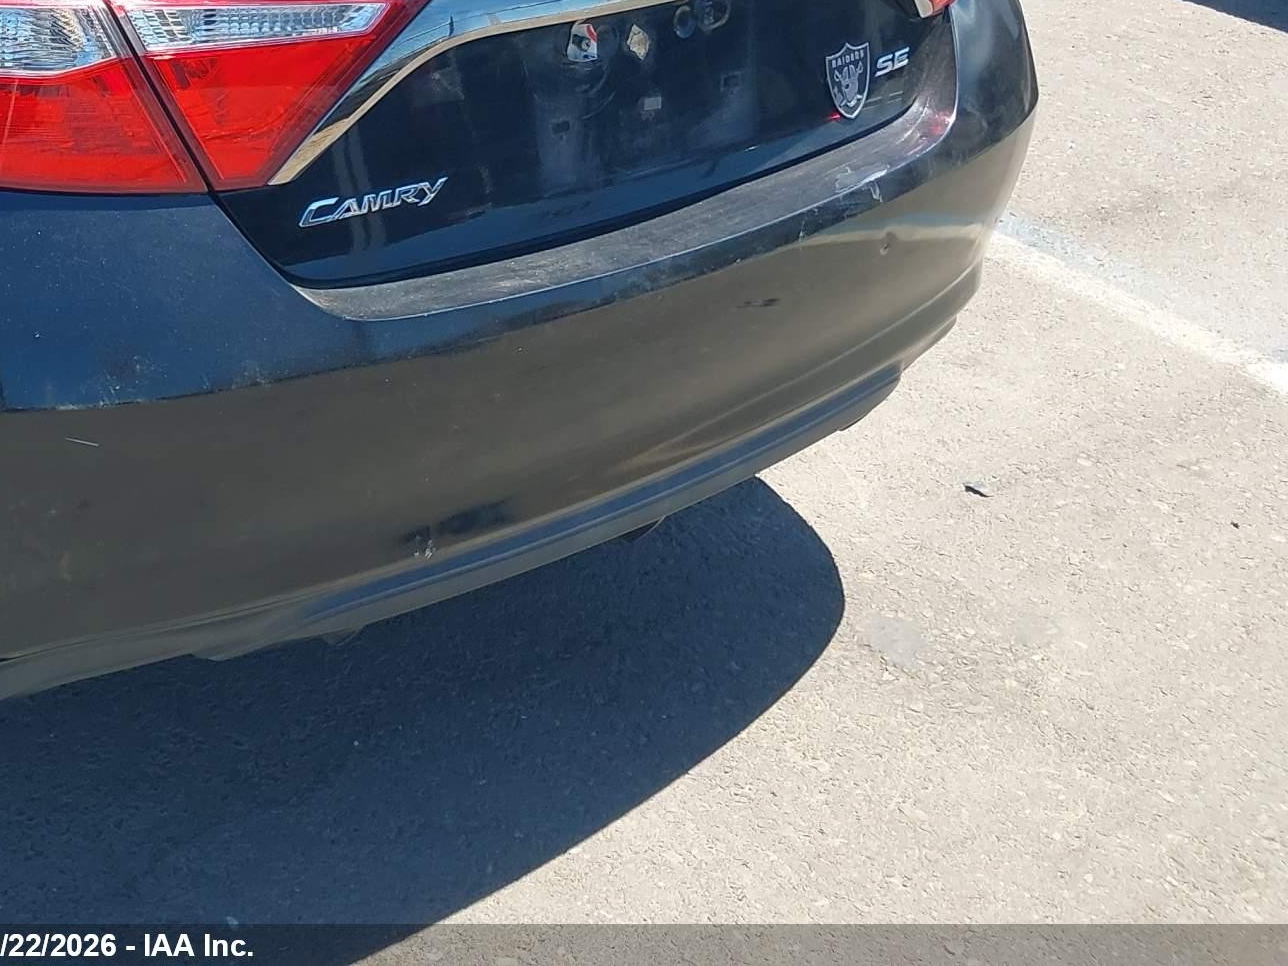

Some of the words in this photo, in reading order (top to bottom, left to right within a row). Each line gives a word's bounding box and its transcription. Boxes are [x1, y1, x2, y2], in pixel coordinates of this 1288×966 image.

[831, 49, 865, 68] RAIDERS
[874, 46, 910, 77] SE
[298, 177, 449, 228] CAMRY
